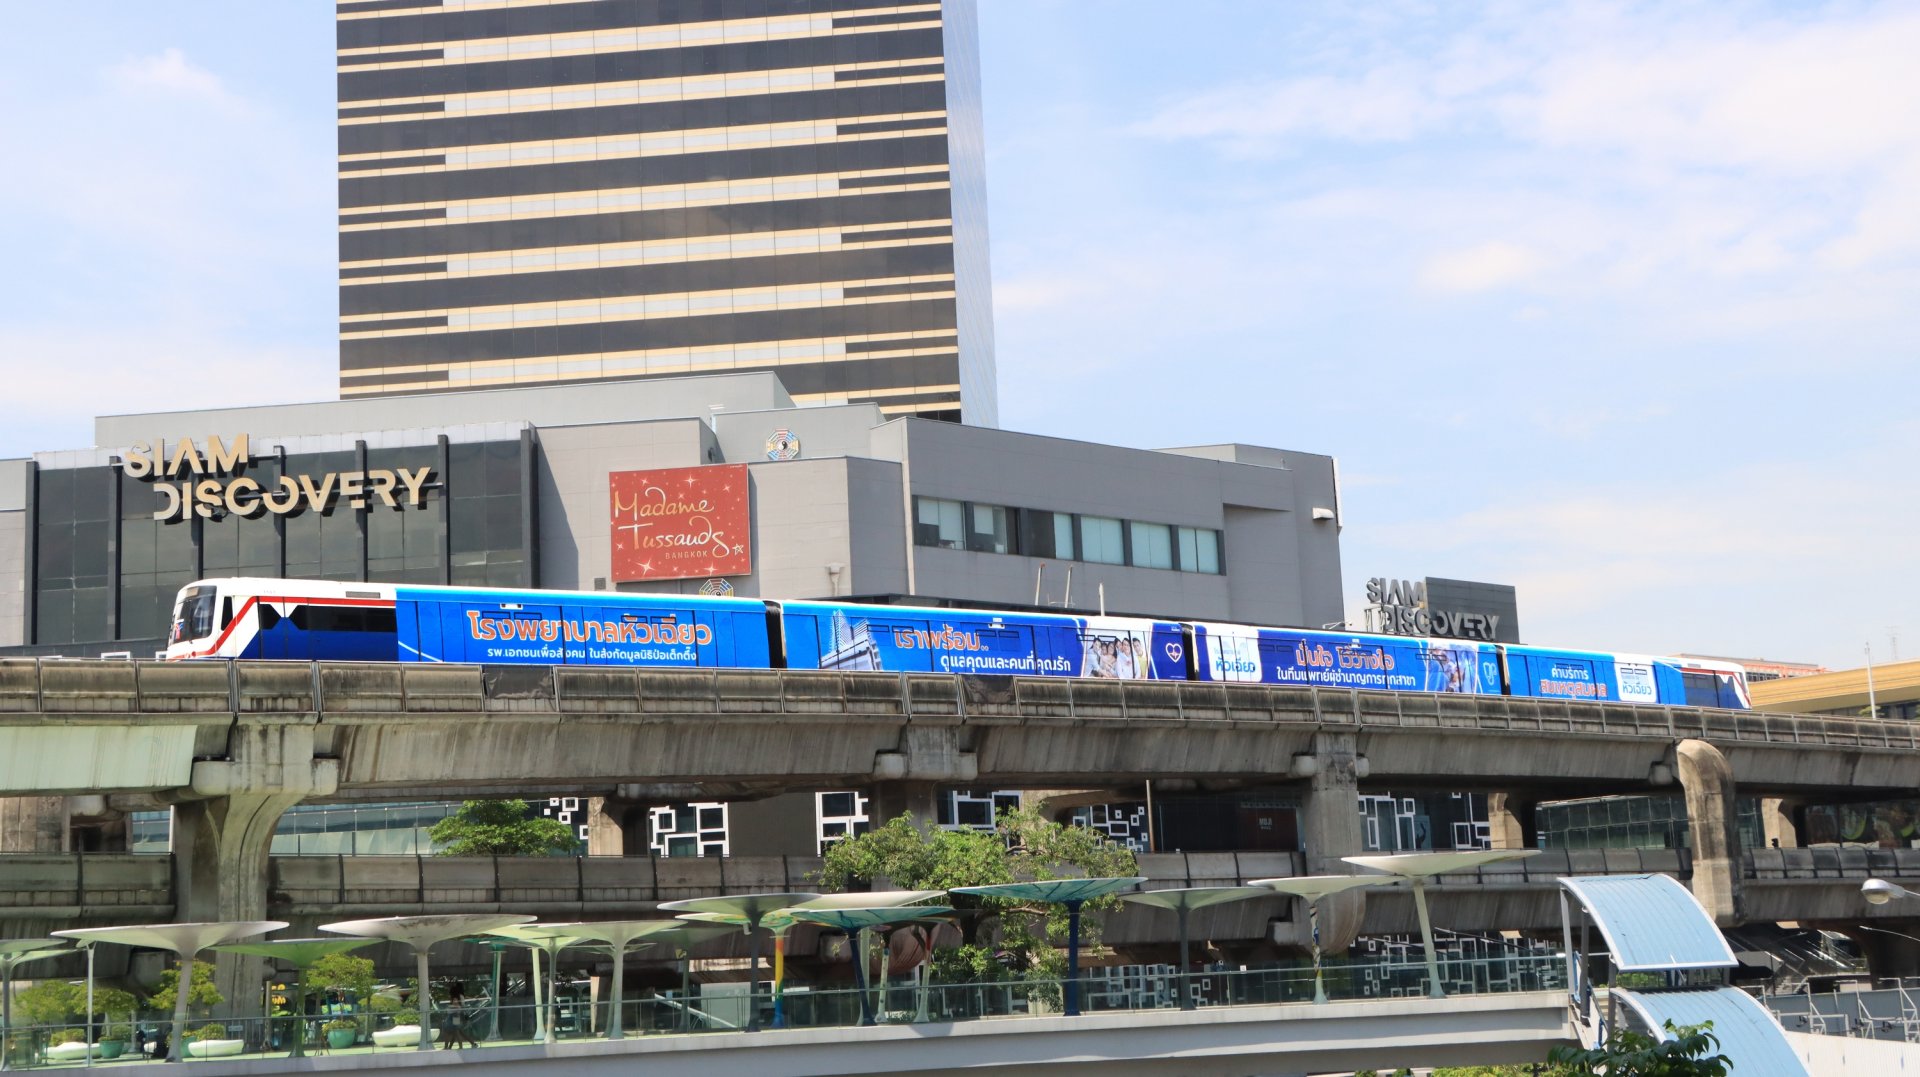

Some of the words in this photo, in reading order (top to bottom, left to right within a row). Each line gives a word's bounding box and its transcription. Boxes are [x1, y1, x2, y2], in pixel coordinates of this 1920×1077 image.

[124, 433, 249, 478] SIAM
[153, 467, 431, 521] DISCOVERY
[614, 487, 714, 521] Madame
[618, 515, 730, 558] Tussauds
[665, 550, 708, 560] BANGKOK
[1366, 577, 1424, 606] SIAM
[467, 610, 713, 646] โรงพยาบาลหัวเฉียว
[1382, 604, 1500, 639] DISCOVERY
[940, 651, 1071, 675] ดูแลคุณและคนที่คุณรัก
